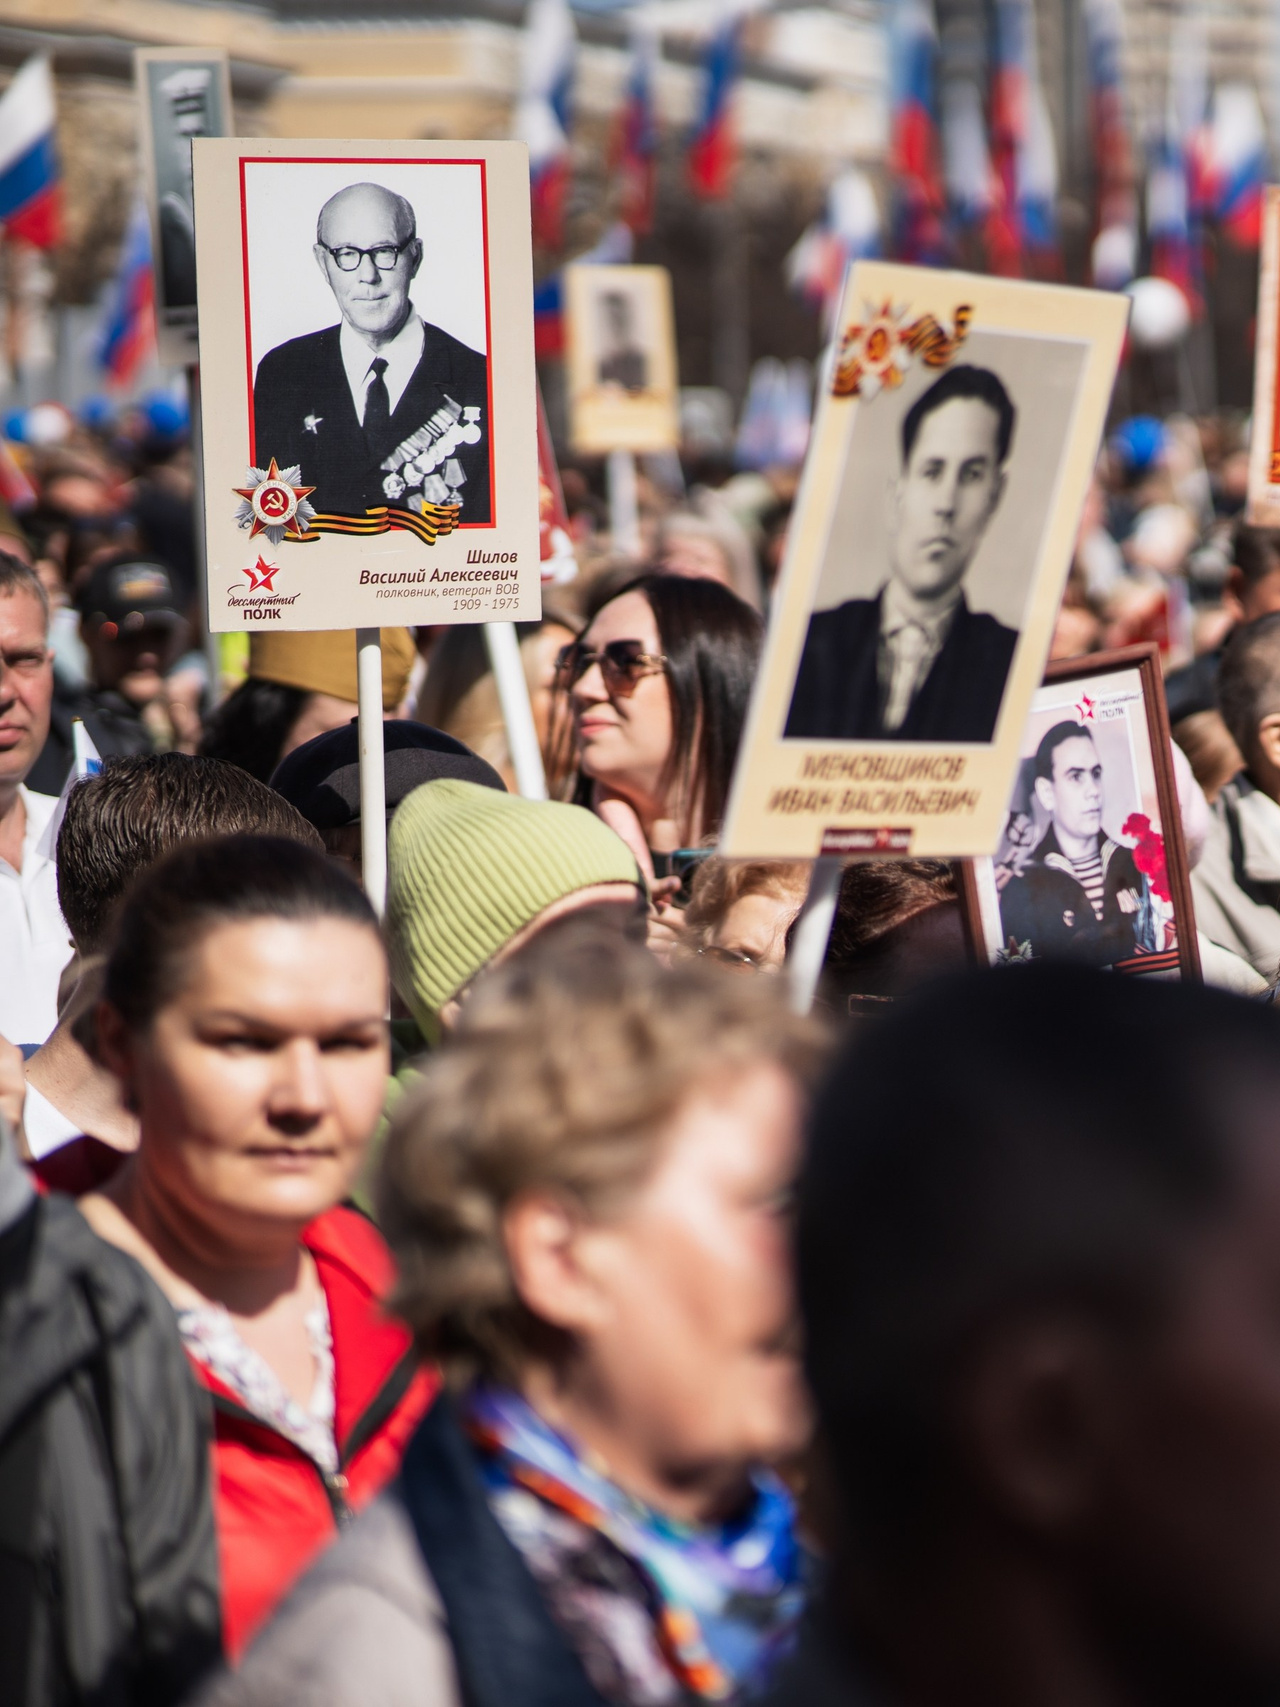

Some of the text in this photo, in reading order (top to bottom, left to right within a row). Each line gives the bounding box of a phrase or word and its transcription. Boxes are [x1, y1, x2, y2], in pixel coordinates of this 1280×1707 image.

[466, 549, 518, 564] Шилов
[359, 568, 518, 585] Василий Алексеевич
[376, 583, 519, 599] полковник, ветеран ВОВ
[452, 599, 481, 611] 1909
[492, 597, 520, 610] 1975
[243, 608, 281, 620] ПОЛК
[801, 754, 966, 781] МЕНОВЩИКОВ
[767, 787, 981, 815] ИВАН ВАСИЛЬЕВИЧ
